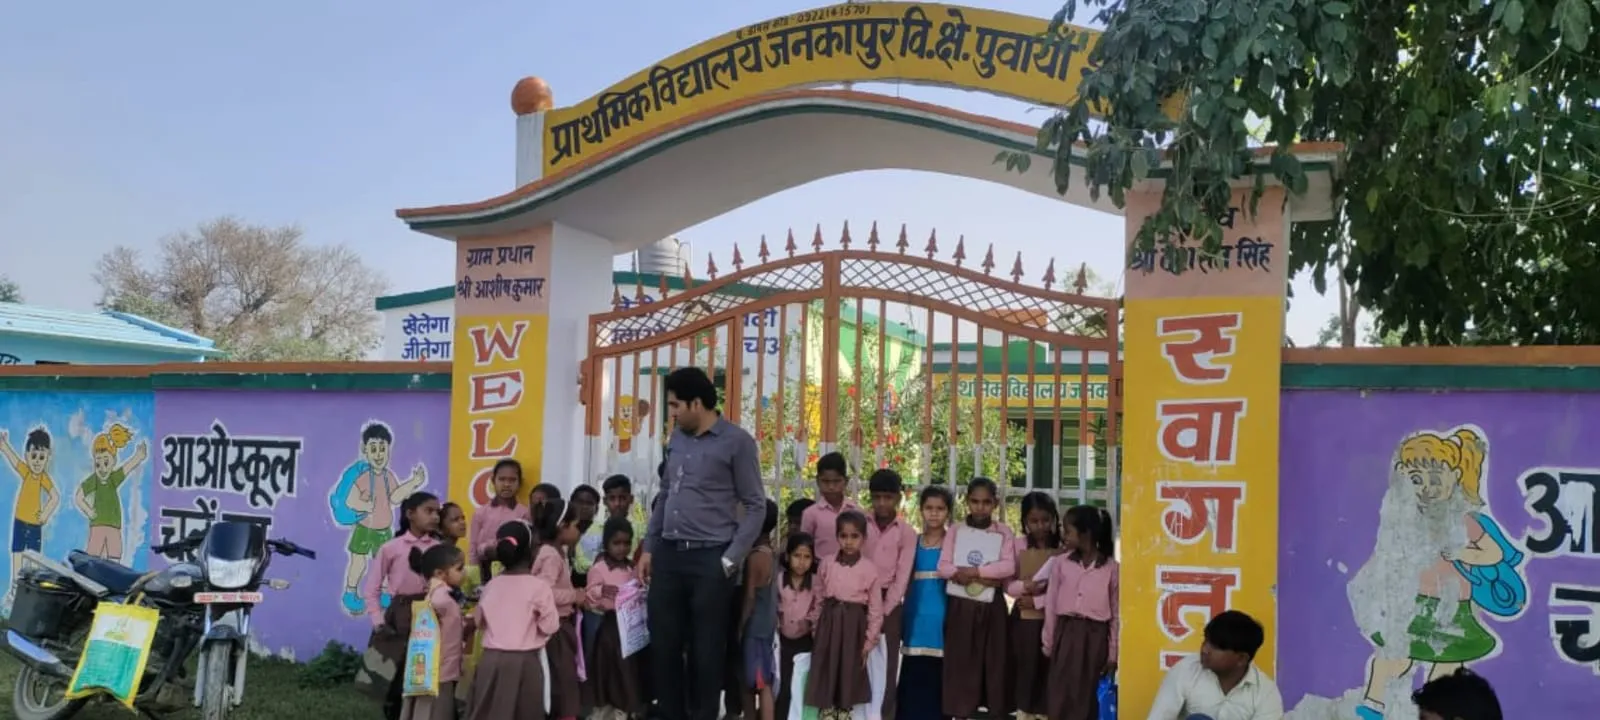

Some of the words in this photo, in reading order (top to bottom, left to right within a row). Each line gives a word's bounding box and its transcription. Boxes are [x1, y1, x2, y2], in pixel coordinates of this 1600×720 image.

[550, 91, 650, 165] प्राथमिक
[648, 35, 763, 111] विद्यालय
[765, 18, 900, 70] जनकापुर
[467, 247, 494, 268] ग्राम
[496, 245, 535, 266] प्रधान
[1236, 236, 1274, 272] सिंह
[457, 275, 472, 300] श्री
[475, 273, 512, 300] आशीष
[512, 277, 546, 302] कुमार
[402, 313, 450, 335] खेलेगा
[401, 336, 451, 360] जीतेगा
[161, 424, 230, 489] आओ
[228, 439, 301, 506] स्कूल
